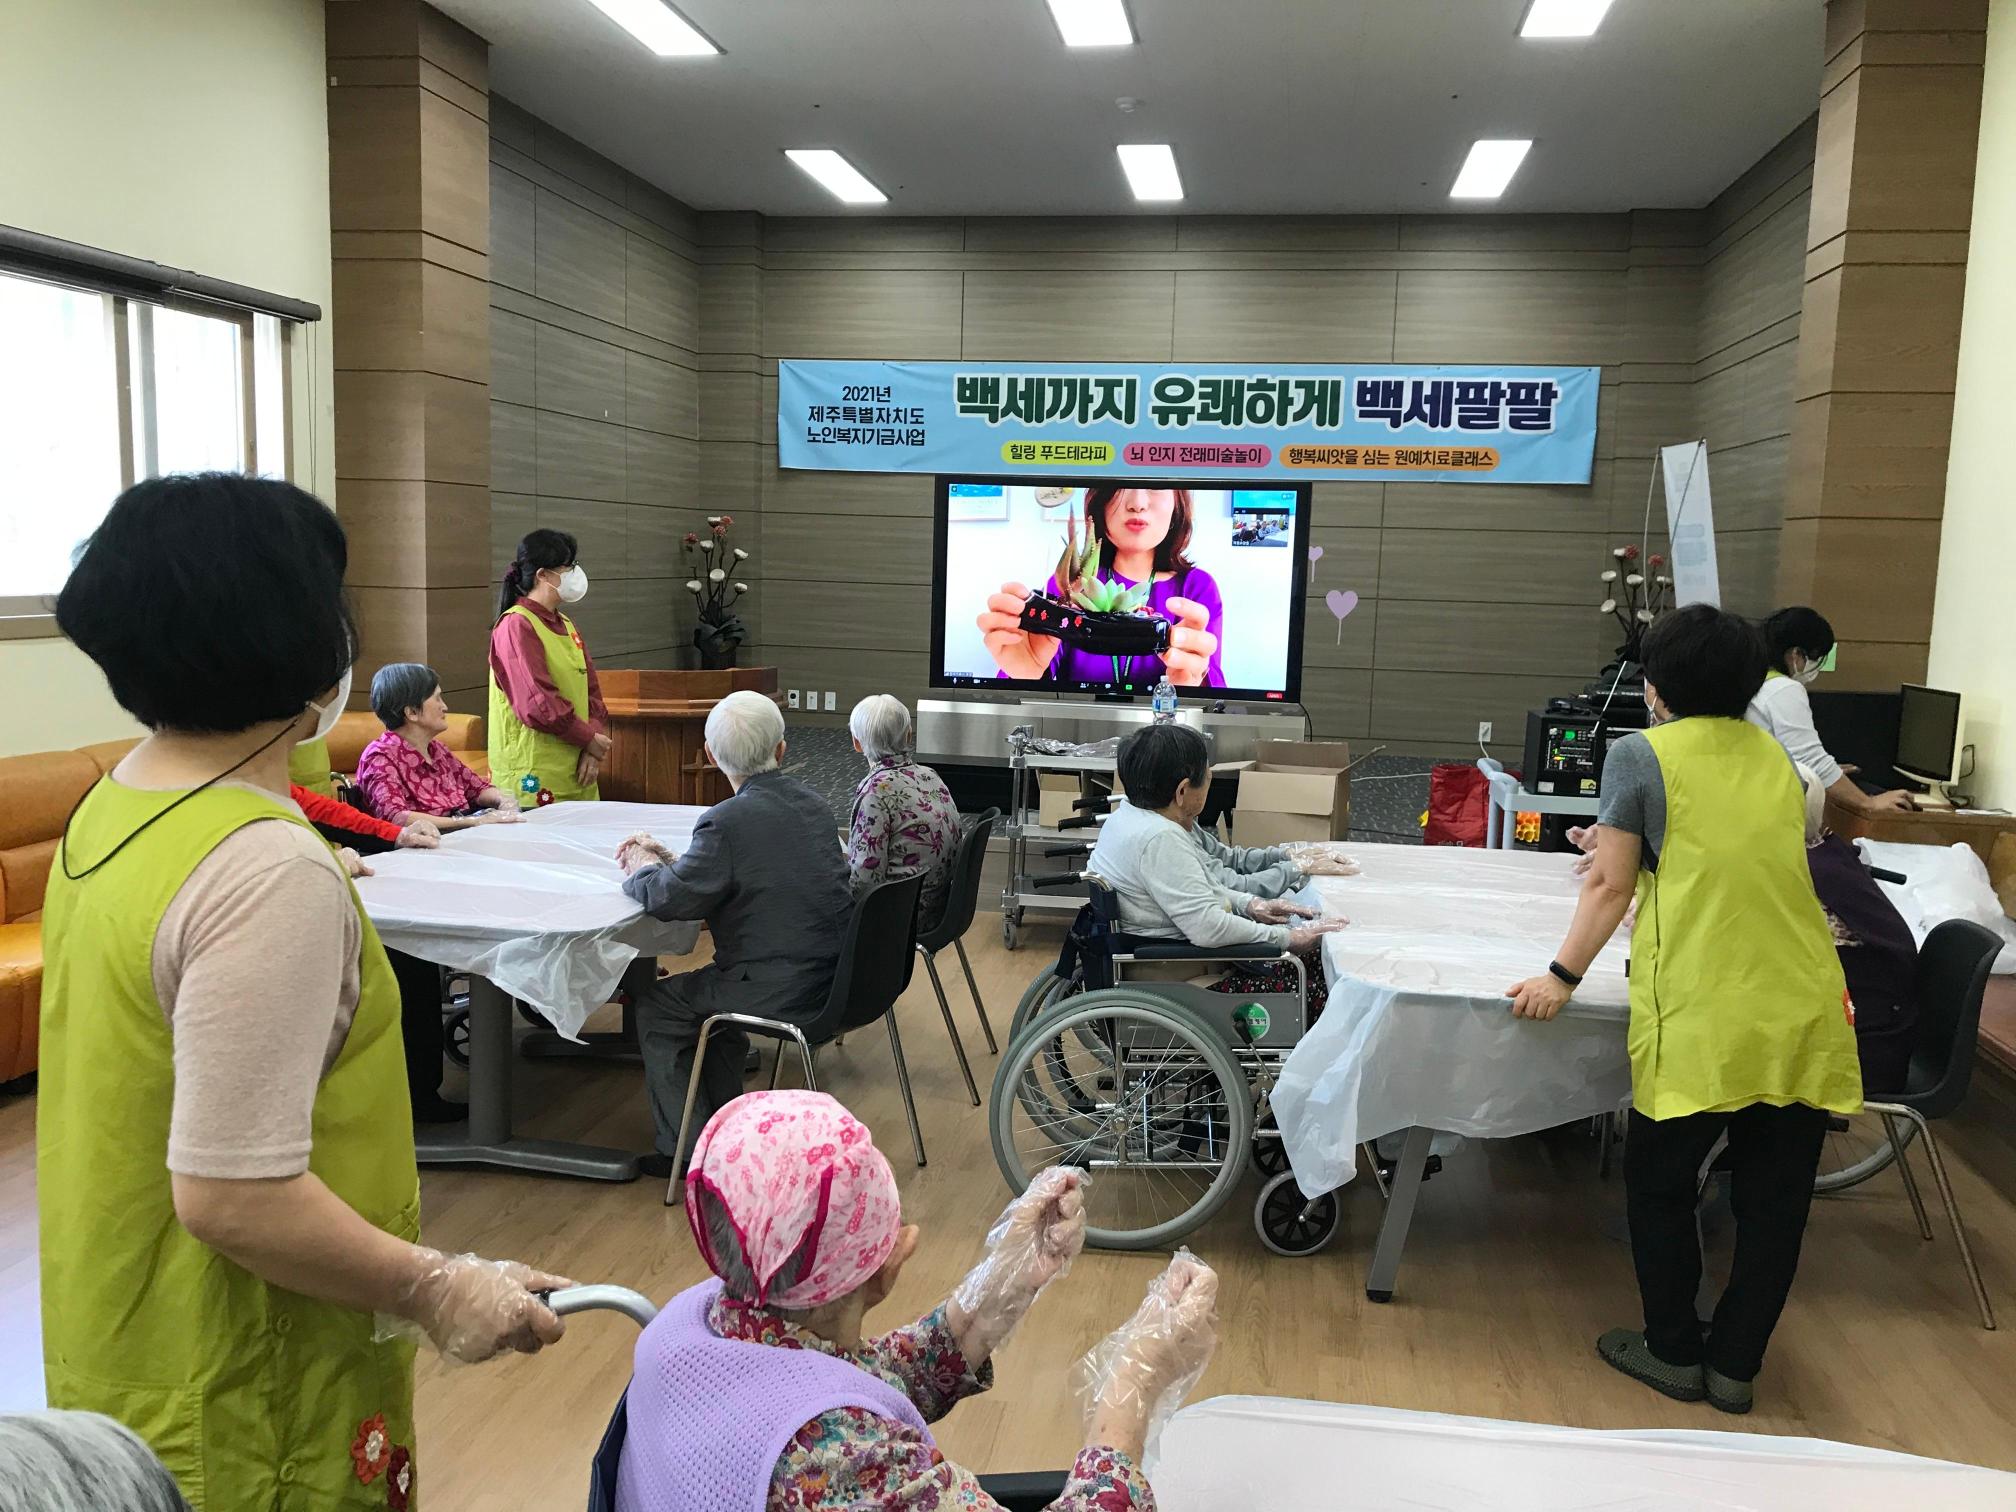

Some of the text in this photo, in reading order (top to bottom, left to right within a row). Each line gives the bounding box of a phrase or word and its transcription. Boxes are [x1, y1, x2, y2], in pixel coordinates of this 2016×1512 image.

[842, 385, 891, 403] 2021년
[956, 376, 1558, 431] 백세까지 유쾌하게 백세팔팔
[807, 405, 925, 425] 제주특별자치도
[806, 426, 926, 447] 노인복지기금사업
[1010, 444, 1107, 461] 힐링 푸드테라피
[1130, 446, 1262, 464] 뇌 인지 전래미술놀이
[1289, 447, 1494, 467] 행복씨앗을 심는 원예치료클래스
